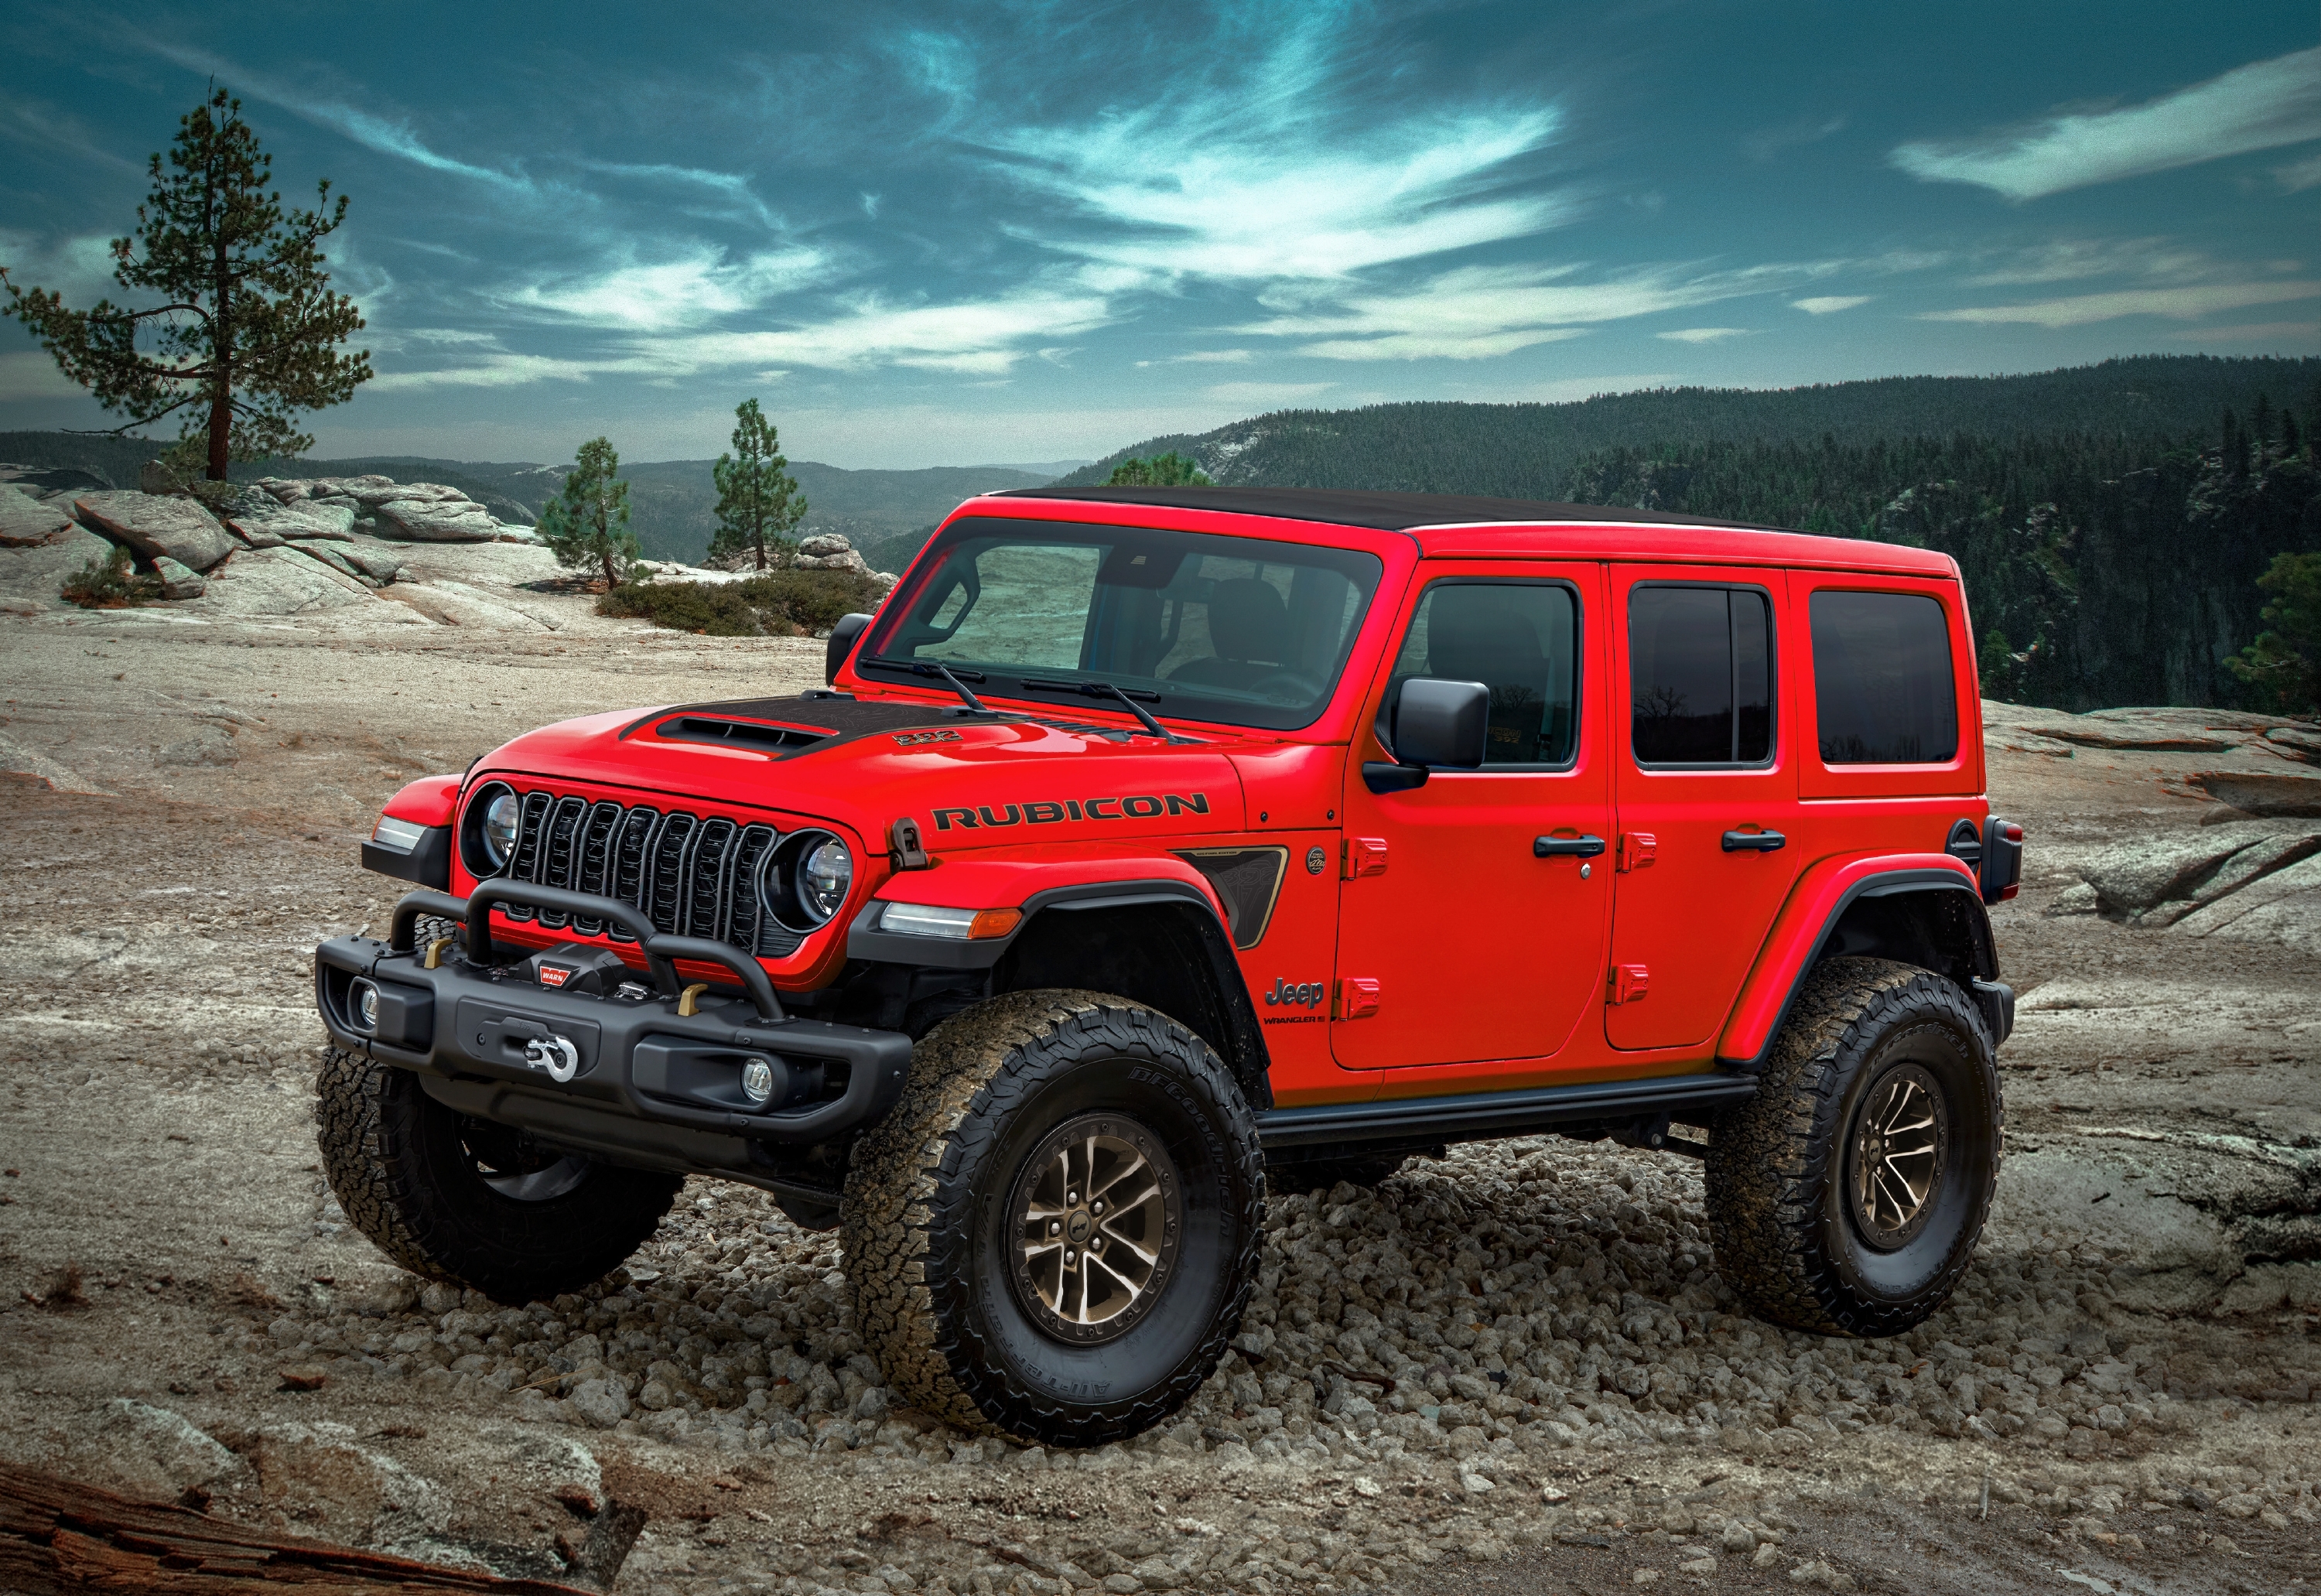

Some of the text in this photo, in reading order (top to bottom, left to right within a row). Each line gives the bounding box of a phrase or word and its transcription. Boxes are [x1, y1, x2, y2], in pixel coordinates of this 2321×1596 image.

[891, 730, 963, 747] 392
[931, 792, 1211, 832] RUBICON
[1222, 867, 1277, 886] 392
[542, 972, 563, 982] WARN
[1266, 977, 1324, 1010] Jeep
[1127, 1066, 1234, 1238] BFGoodrich
